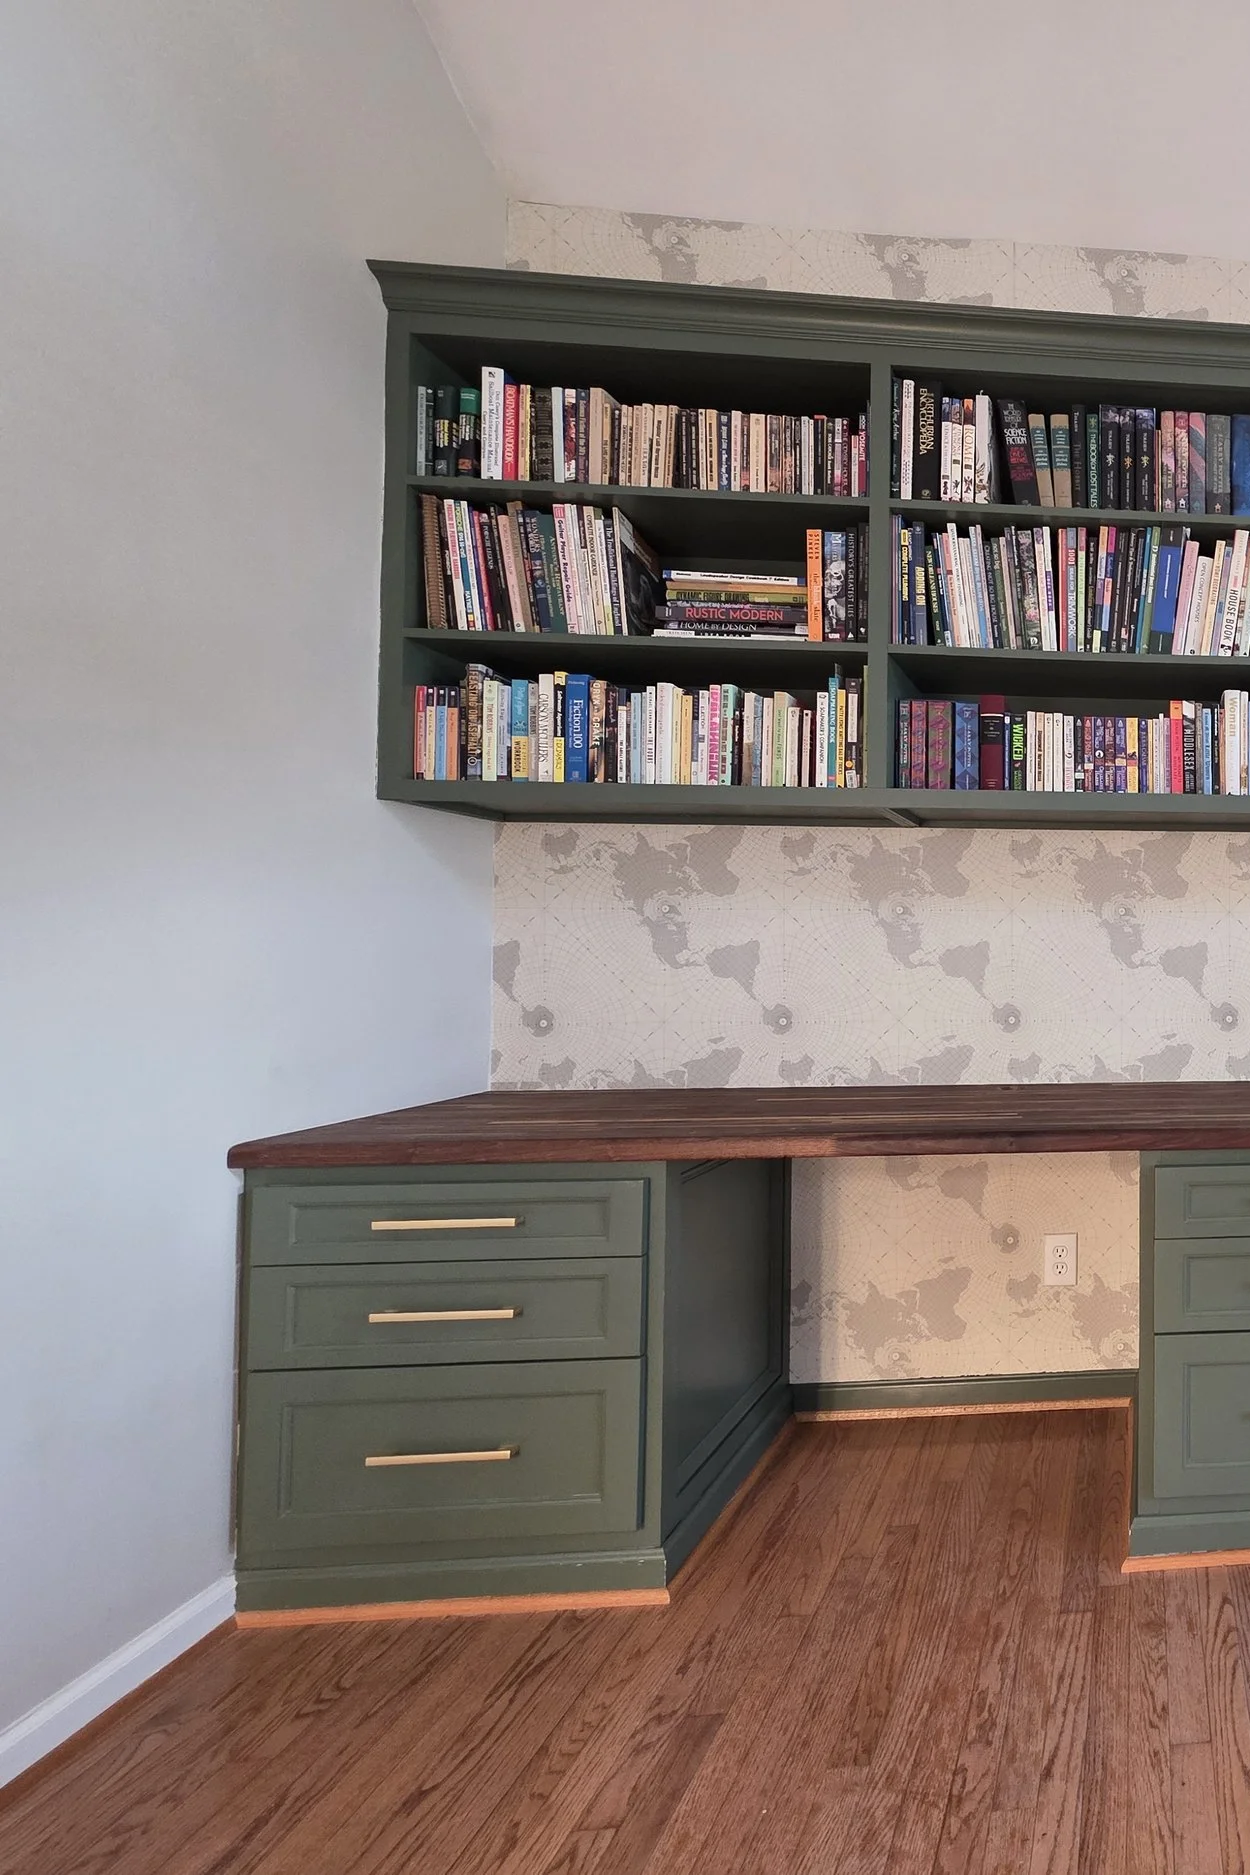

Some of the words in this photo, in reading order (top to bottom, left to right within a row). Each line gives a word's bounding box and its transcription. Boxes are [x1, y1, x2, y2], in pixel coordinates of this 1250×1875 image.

[487, 408, 495, 448] Maintenance
[919, 388, 928, 454] ENCYCLOPEDIA
[1004, 428, 1027, 436] SCIENCE
[505, 426, 514, 463] HANDBOOK
[964, 428, 974, 463] ROME
[1006, 436, 1027, 445] FICTION
[559, 541, 567, 561] Player
[607, 539, 616, 569] Traditional
[950, 529, 959, 567] UNDERSTANDING
[927, 564, 936, 589] ORLEANS
[993, 561, 1001, 569] big
[609, 570, 617, 595] Buildings
[915, 567, 925, 593] ADDING
[1197, 577, 1206, 600] CONCEPT
[612, 595, 619, 603] of
[916, 595, 926, 605] ON
[930, 590, 939, 613] HOUSES
[1226, 589, 1238, 616] HOUSE
[613, 603, 621, 626] England
[680, 621, 710, 629] HOME
[722, 622, 757, 631] DESIGN
[685, 607, 726, 619] RUSTIC
[729, 609, 783, 621] MODERN
[1068, 592, 1076, 637] TRIMWORK
[1224, 619, 1235, 641] BOOK
[468, 671, 479, 707] FEASTING
[468, 710, 478, 720] ON
[539, 694, 549, 722] CARSON
[573, 700, 584, 731] Fiction
[1229, 697, 1237, 737] Woman
[468, 722, 478, 756] ASPHALT
[573, 733, 583, 748] 100
[592, 717, 600, 746] CRAKE
[1013, 724, 1023, 760] WICKED
[1183, 729, 1194, 770] MIDDLESEX
